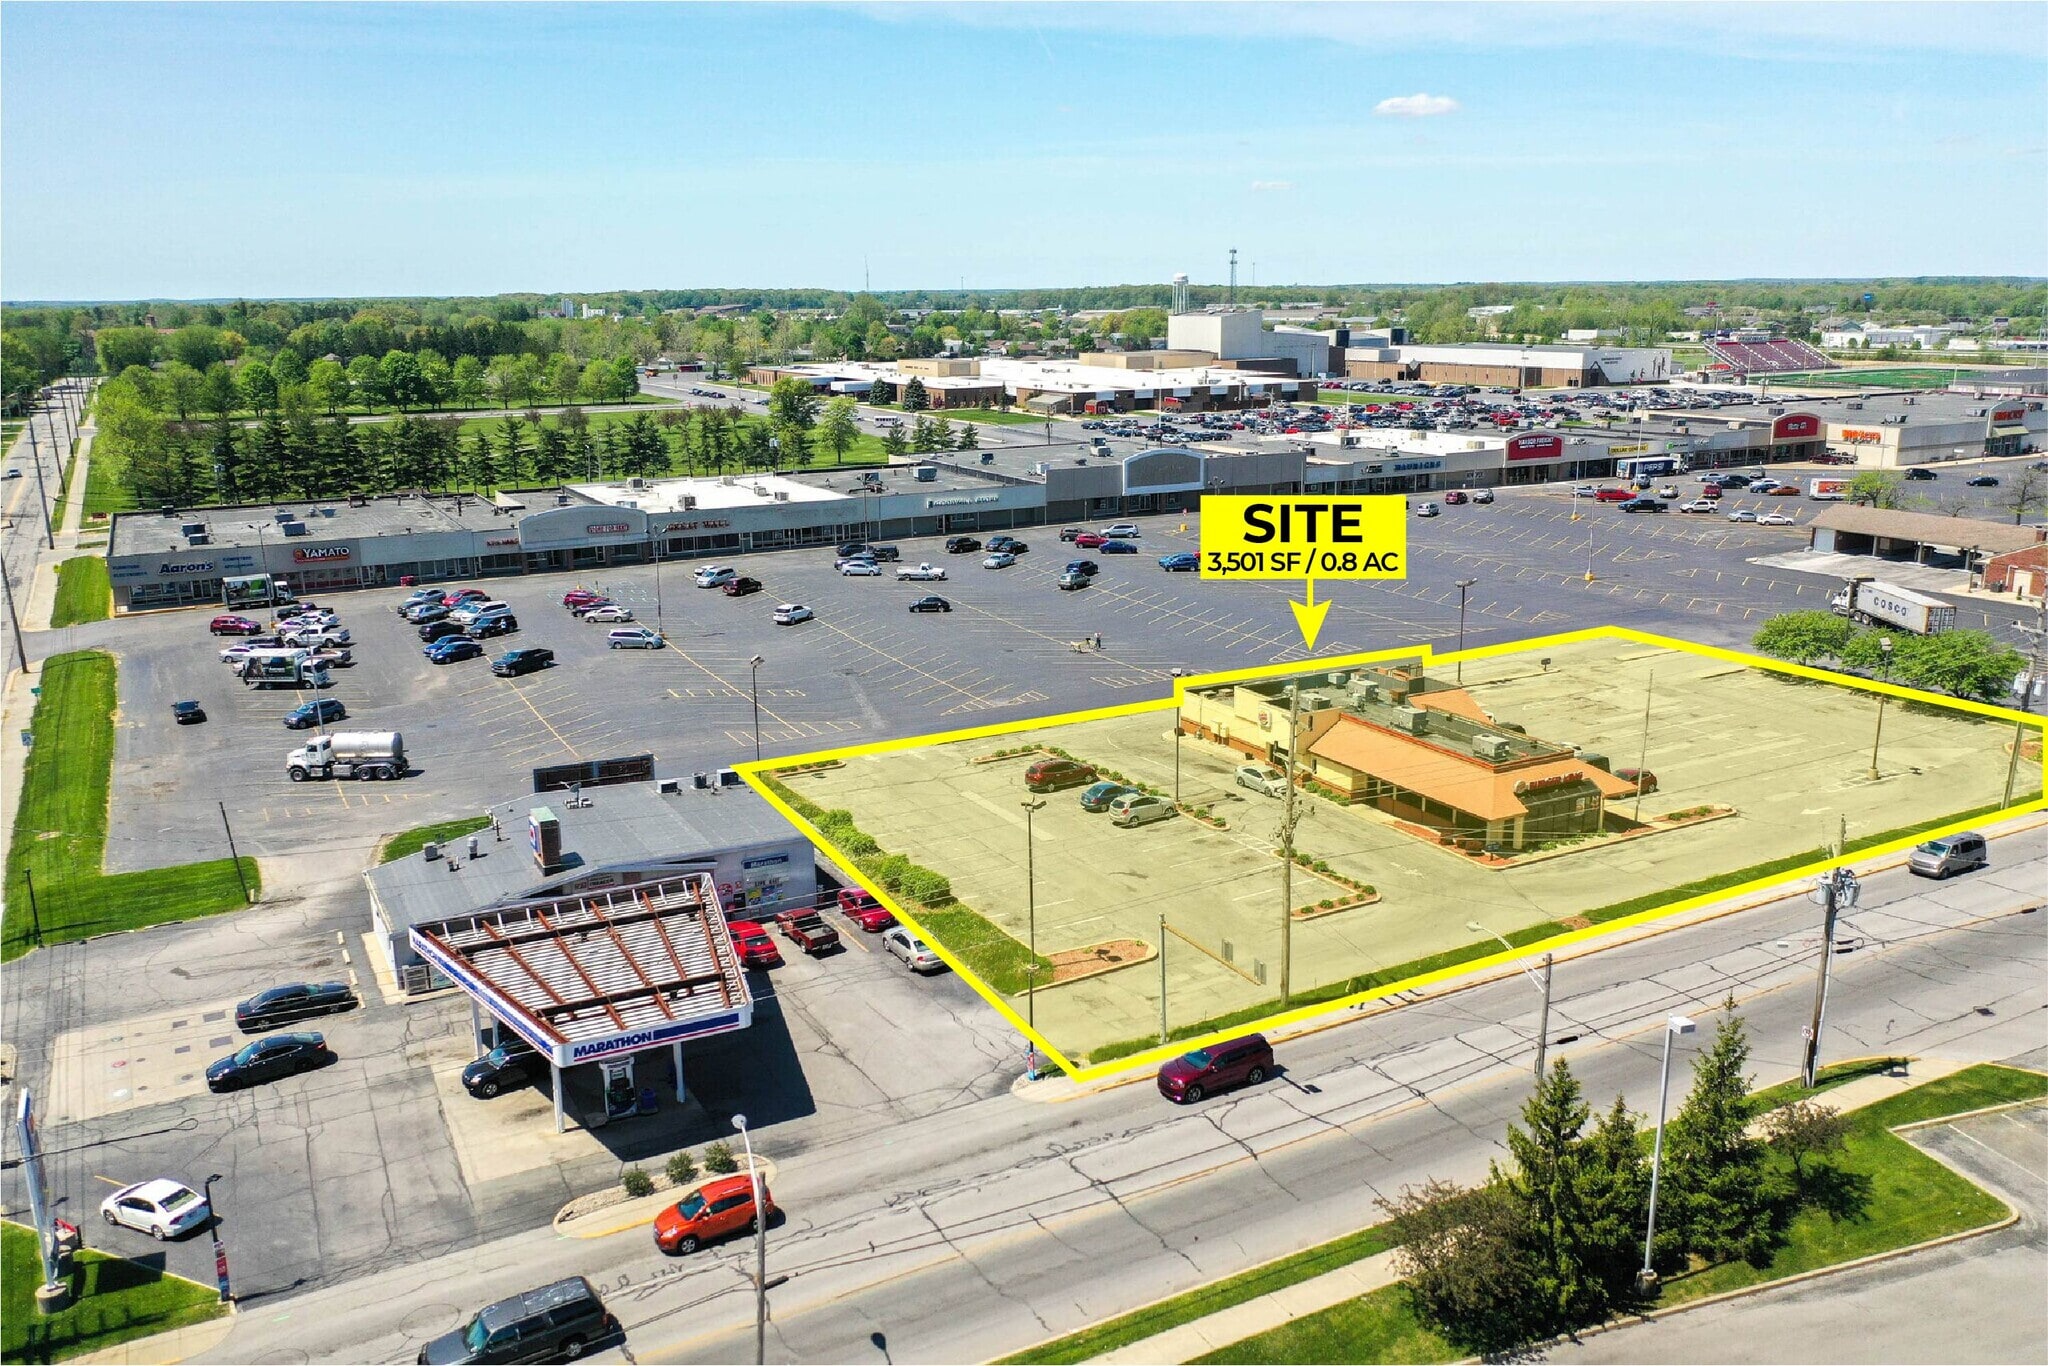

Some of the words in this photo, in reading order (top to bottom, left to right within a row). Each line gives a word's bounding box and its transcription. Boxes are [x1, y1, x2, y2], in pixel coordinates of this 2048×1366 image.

[303, 547, 350, 558] YAMATO
[158, 560, 214, 574] Aaron's
[1873, 596, 1907, 616] COSCO
[573, 1031, 652, 1058] MARATHON
